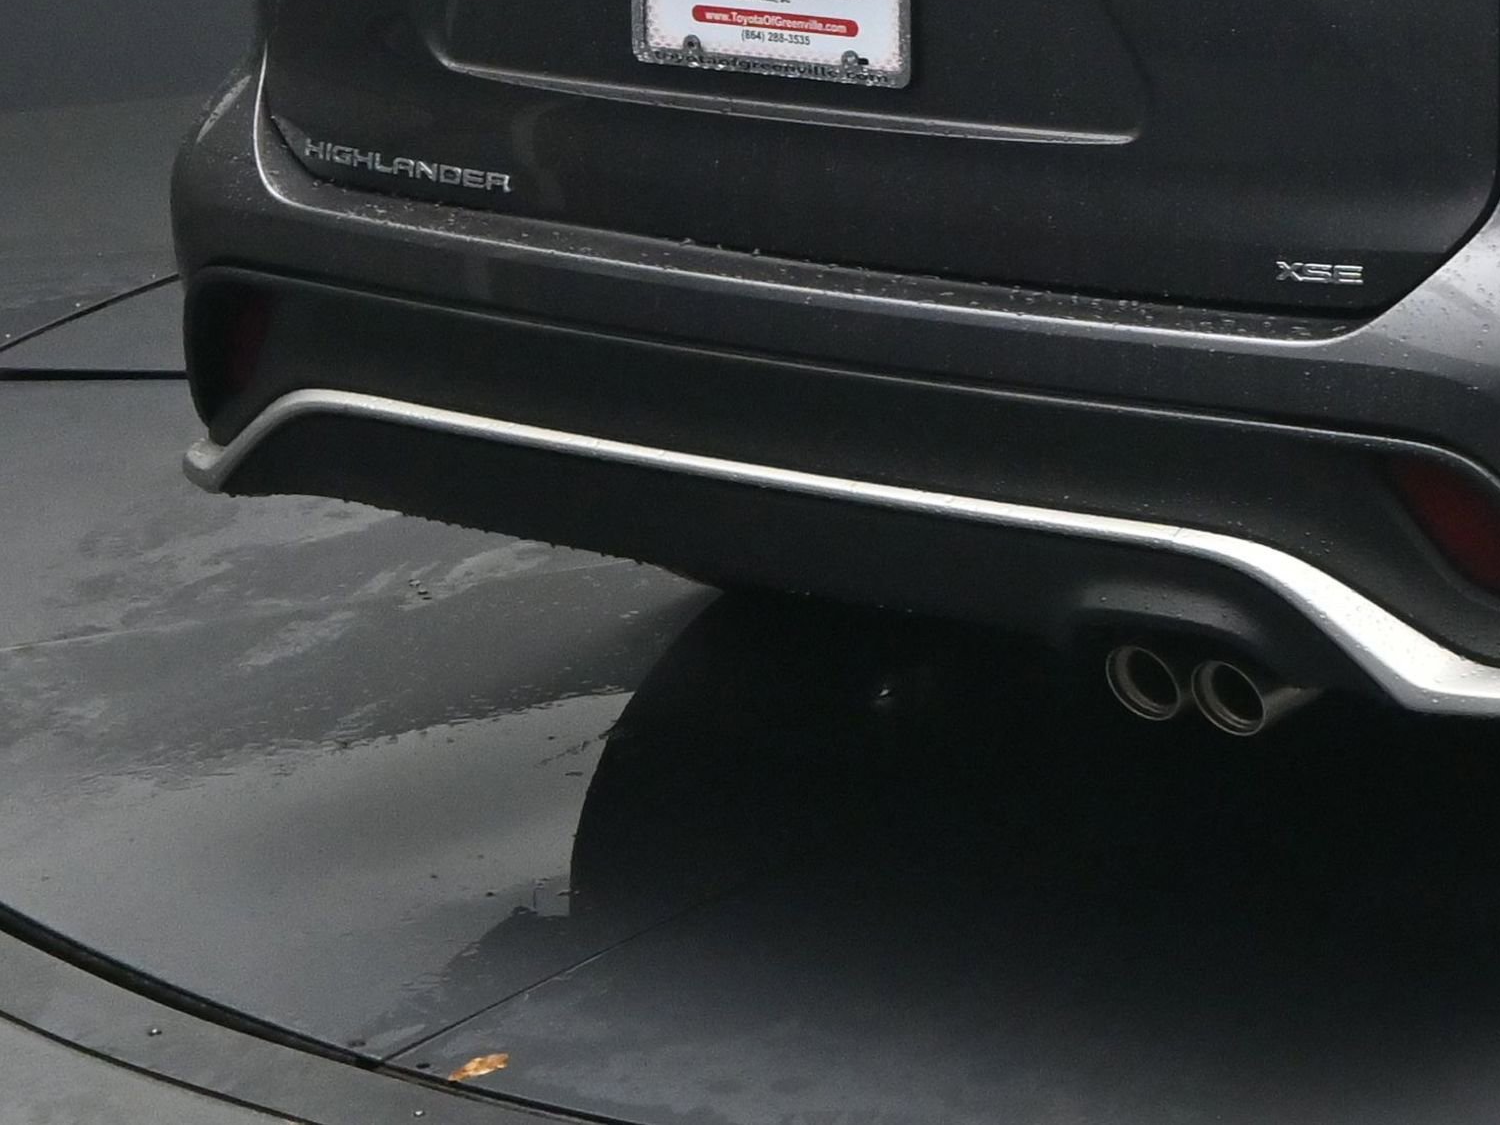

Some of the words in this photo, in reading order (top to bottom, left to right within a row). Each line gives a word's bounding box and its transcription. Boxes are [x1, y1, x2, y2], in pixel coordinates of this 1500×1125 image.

[705, 11, 847, 33] www.ToyotaOfGreenville.com
[741, 29, 765, 43] (864)
[767, 31, 811, 46] 288-3535
[655, 51, 888, 82] toyotaofgreenvillecom
[304, 138, 512, 193] HIGHLANDER
[1275, 260, 1364, 284] XSE
